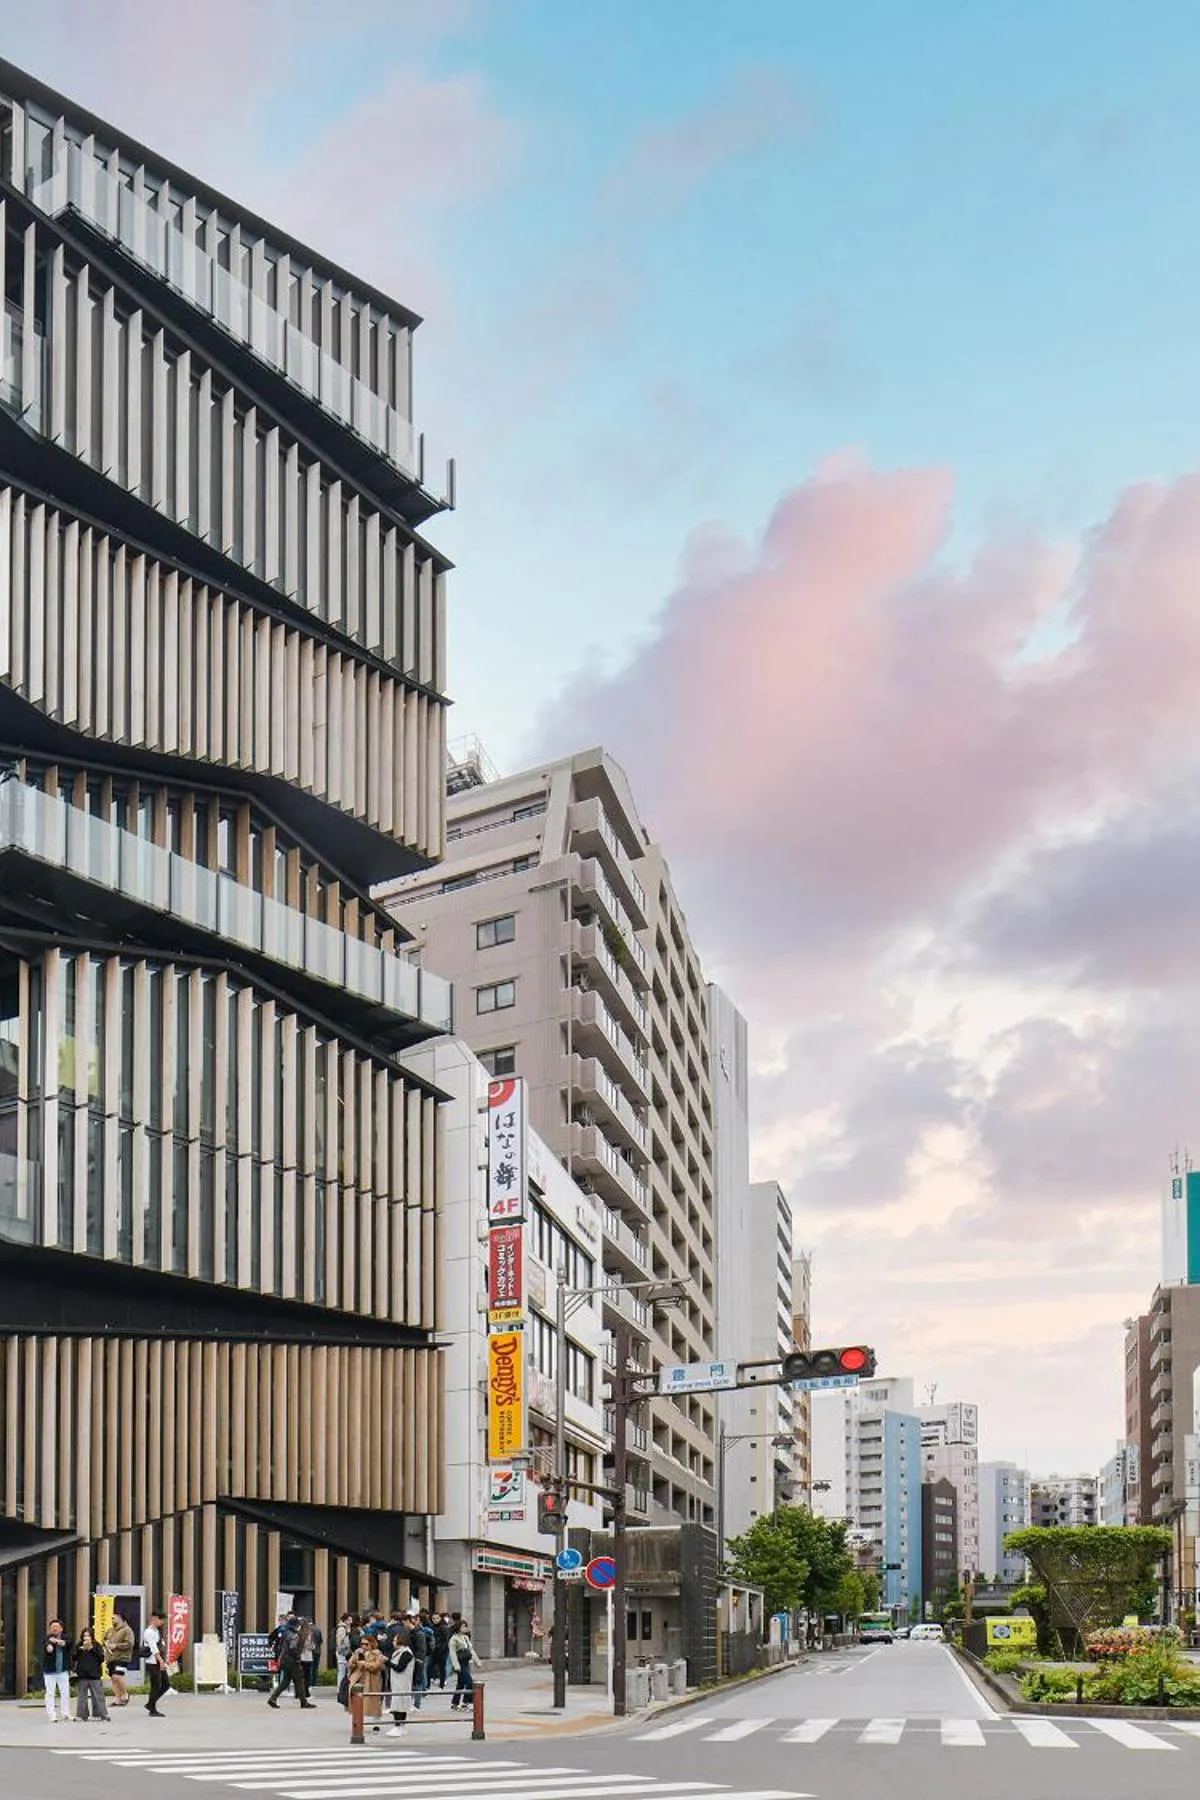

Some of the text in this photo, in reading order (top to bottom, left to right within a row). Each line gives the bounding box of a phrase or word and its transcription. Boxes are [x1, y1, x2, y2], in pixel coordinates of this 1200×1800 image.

[495, 1111, 518, 1191] はなの舞
[492, 1198, 519, 1215] 4F
[491, 1337, 520, 1406] Denny's
